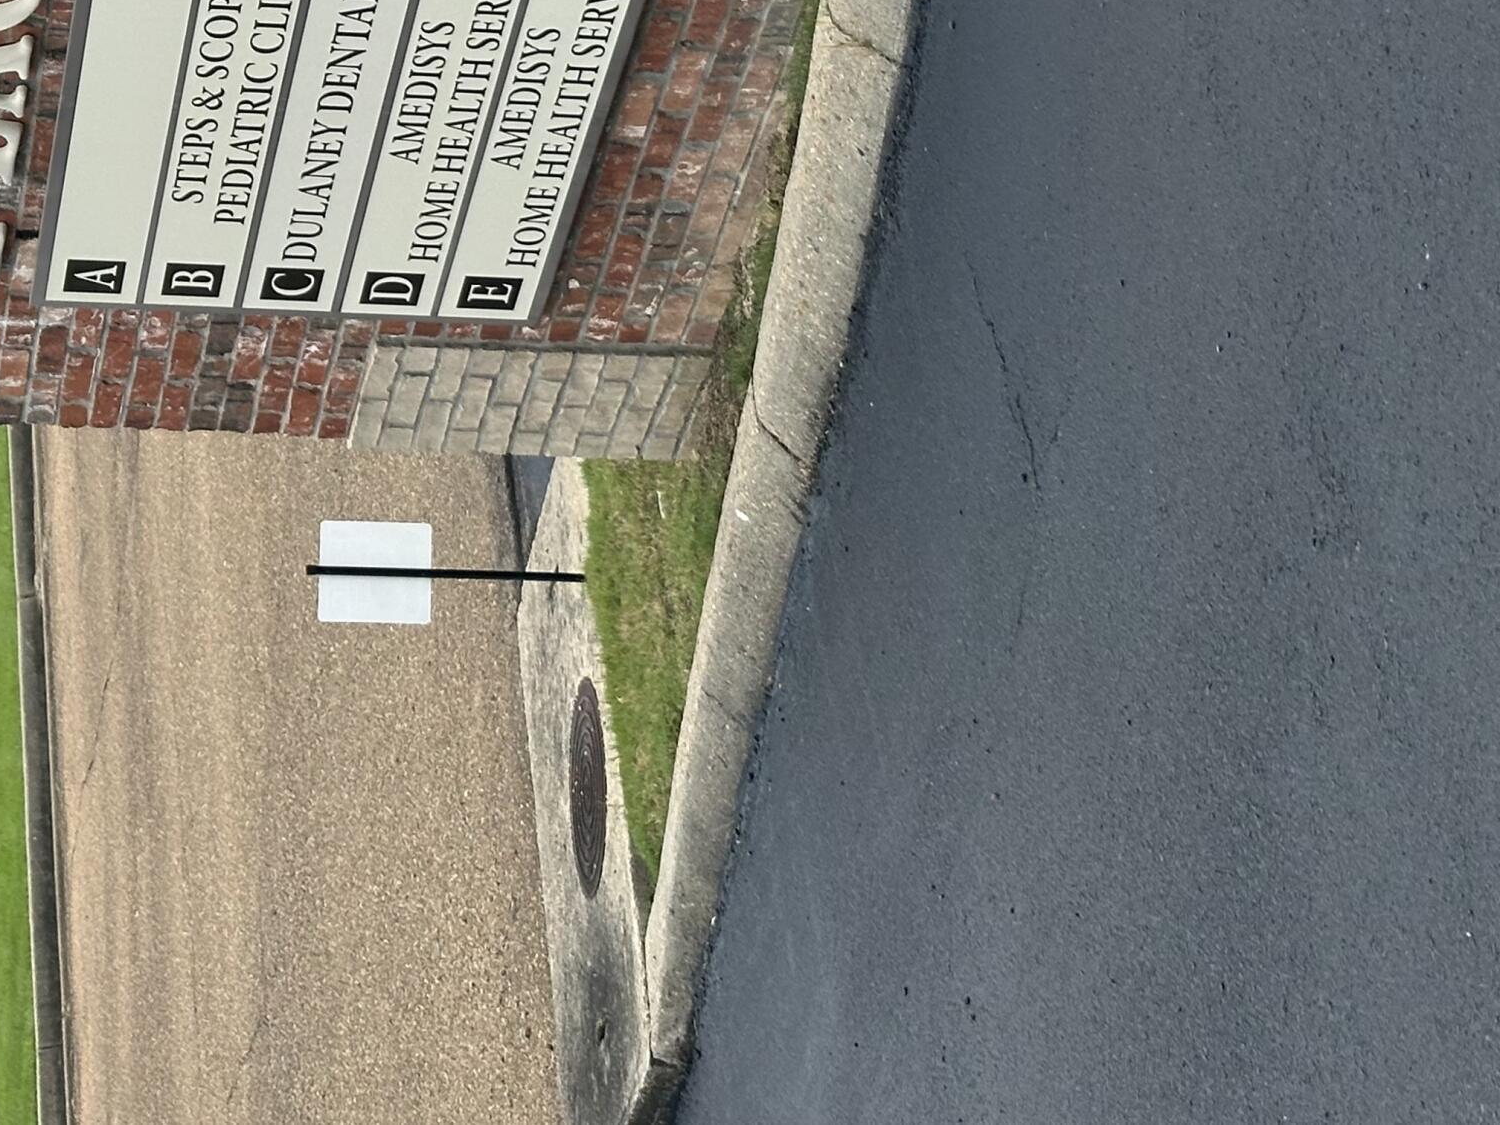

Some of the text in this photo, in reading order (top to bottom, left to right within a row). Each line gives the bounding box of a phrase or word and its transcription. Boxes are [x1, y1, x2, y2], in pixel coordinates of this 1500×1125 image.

[191, 86, 226, 111] &
[389, 21, 456, 165] AMEDISYS
[431, 57, 495, 175] HEALTH
[490, 27, 561, 171] AMEDISYS
[532, 63, 600, 181] HEALTH
[171, 118, 219, 204] STEPS
[213, 62, 279, 225] PEDIATRIC
[281, 118, 348, 263] DULANEY
[407, 179, 460, 263] HOME
[505, 186, 561, 268] HOME
[73, 265, 119, 290] A
[170, 269, 214, 292] B
[270, 272, 317, 297] C
[368, 276, 415, 303] D
[466, 282, 513, 304] E
